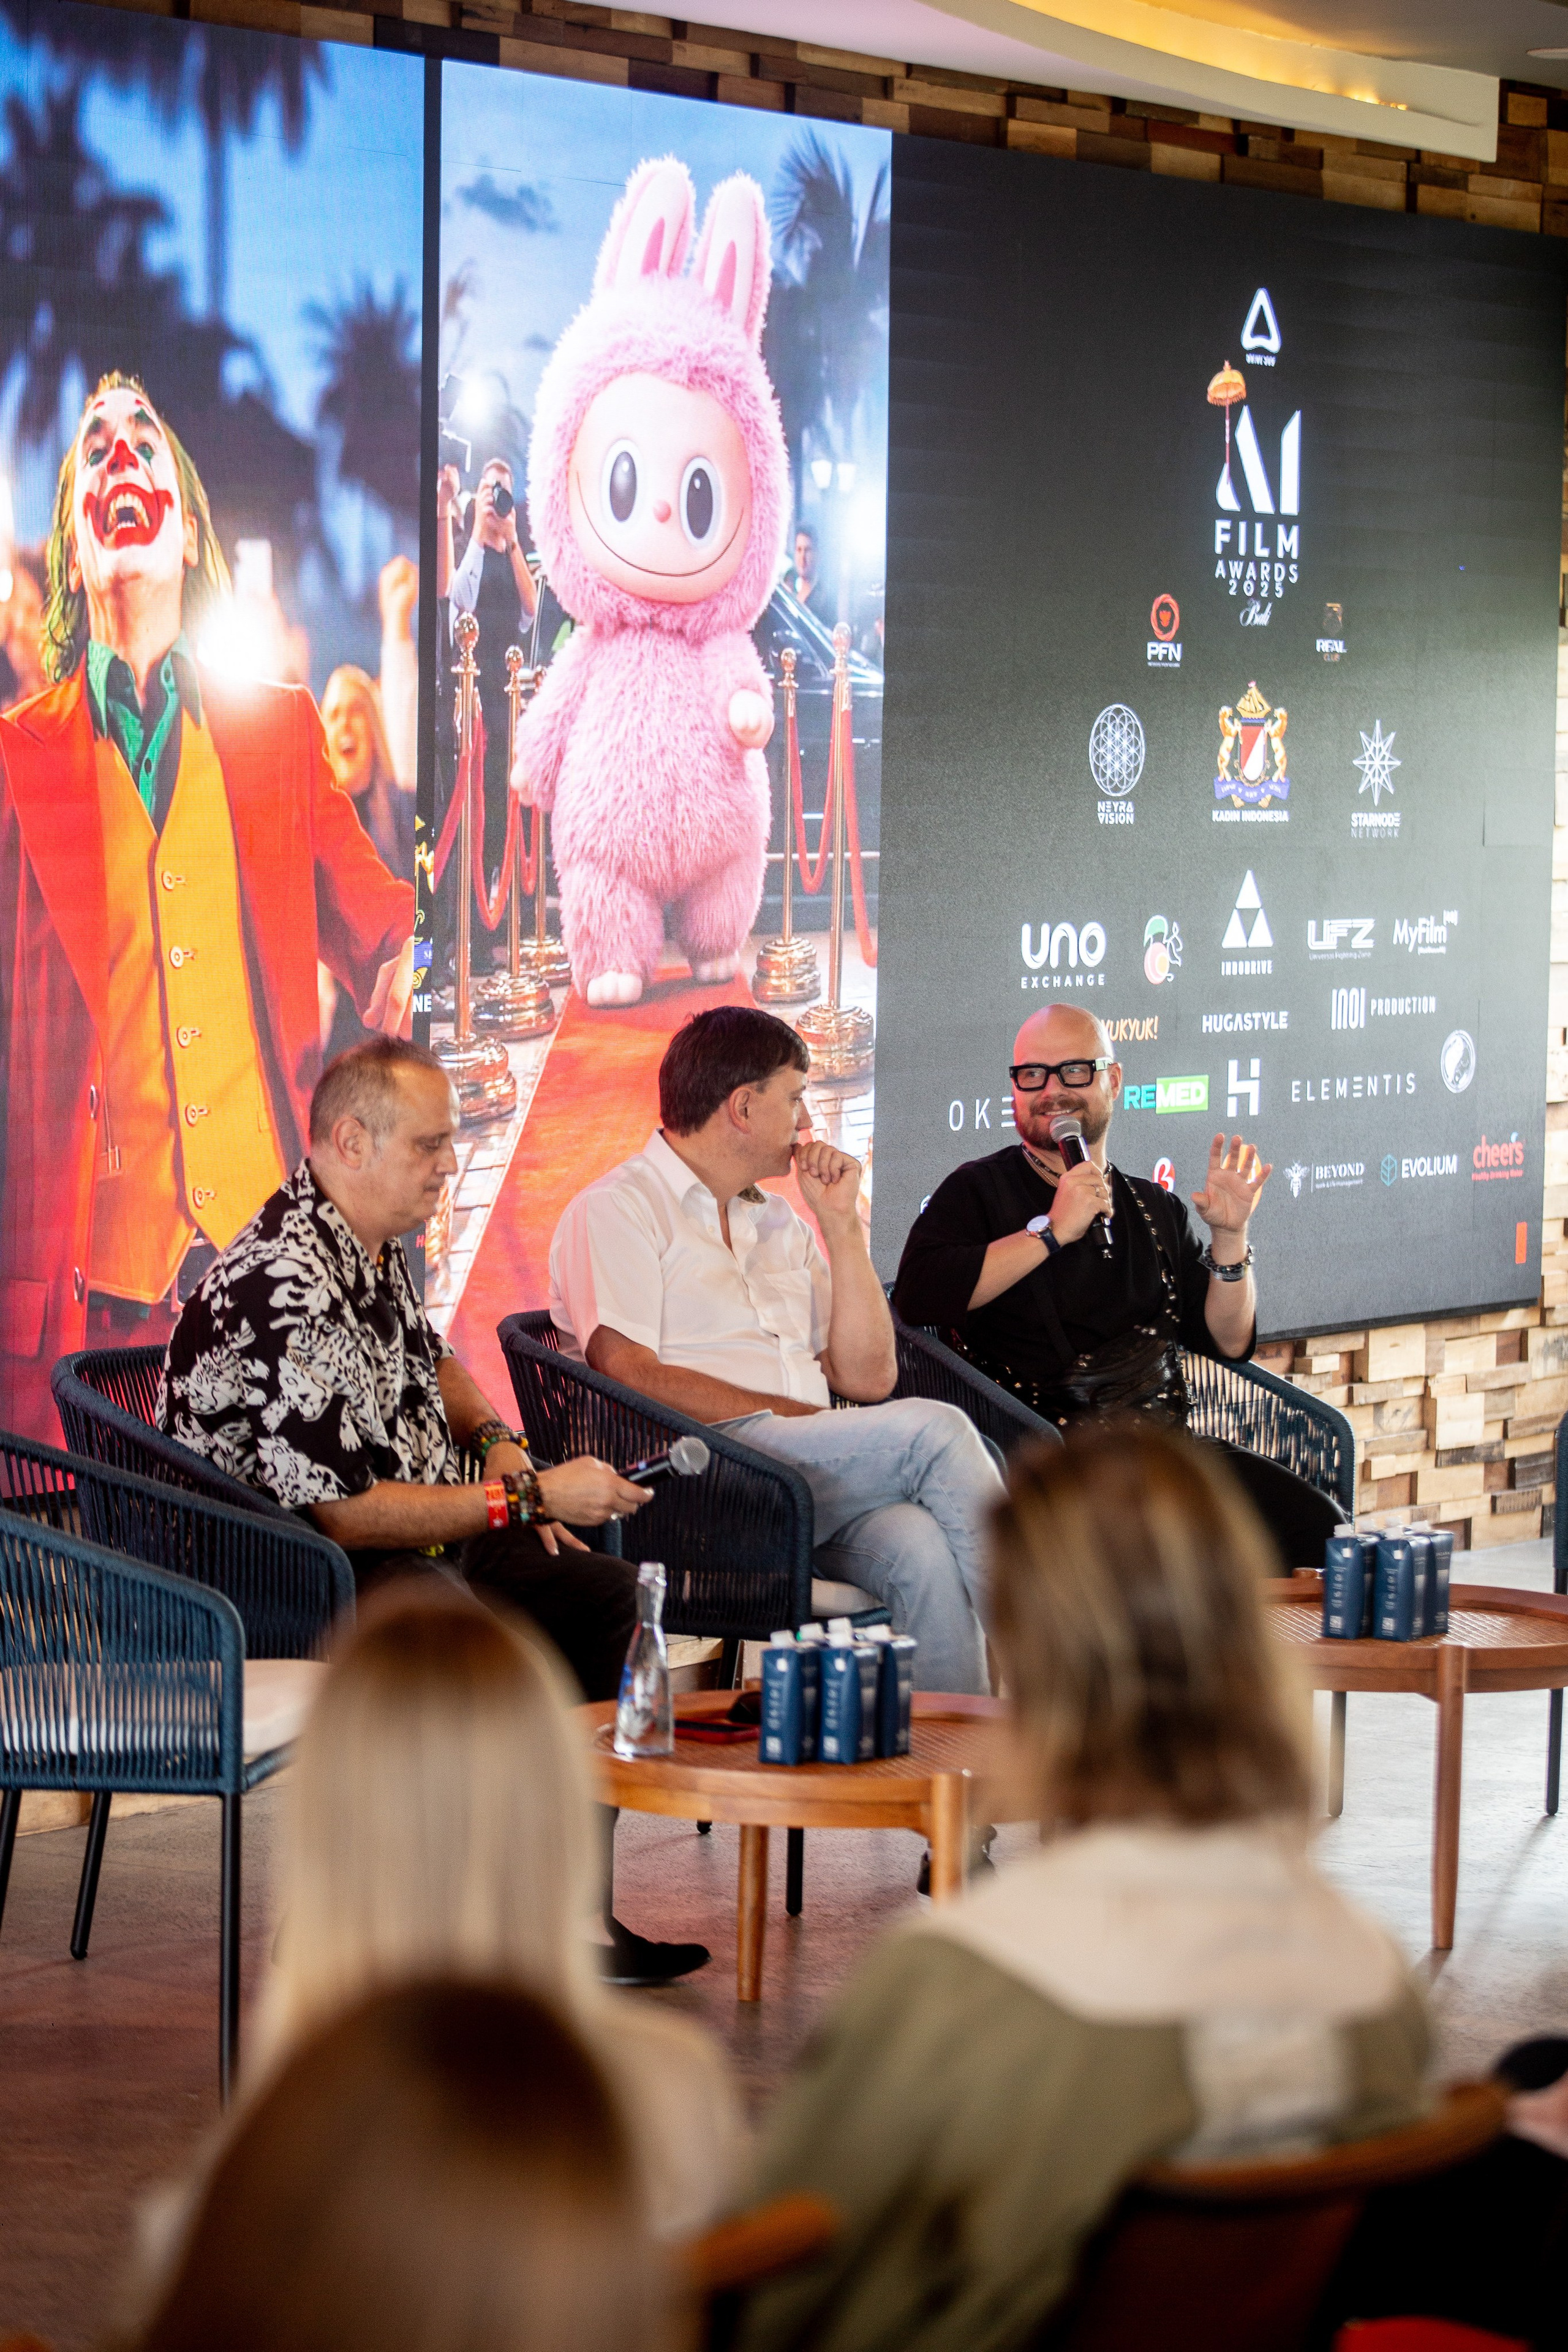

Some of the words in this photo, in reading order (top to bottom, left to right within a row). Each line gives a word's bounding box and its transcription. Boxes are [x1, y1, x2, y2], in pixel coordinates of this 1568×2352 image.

[1215, 519, 1299, 560] FILM
[1215, 559, 1299, 584] AWARDS
[1229, 578, 1284, 598] 2025
[1147, 641, 1182, 662] PFN
[1097, 800, 1134, 813] NEYRA
[1097, 812, 1134, 824] VISION
[1351, 812, 1401, 827] STARNODE
[1393, 914, 1447, 953] MyFilm
[1021, 974, 1105, 989] EXCHANGE
[1370, 995, 1436, 1017] PRODUCTION
[1202, 1011, 1289, 1033] HUGASTYLE
[1291, 1072, 1416, 1102] ELEMENTIS
[1315, 1162, 1365, 1180] BEYOND
[1401, 1154, 1459, 1178] EVOLIUM
